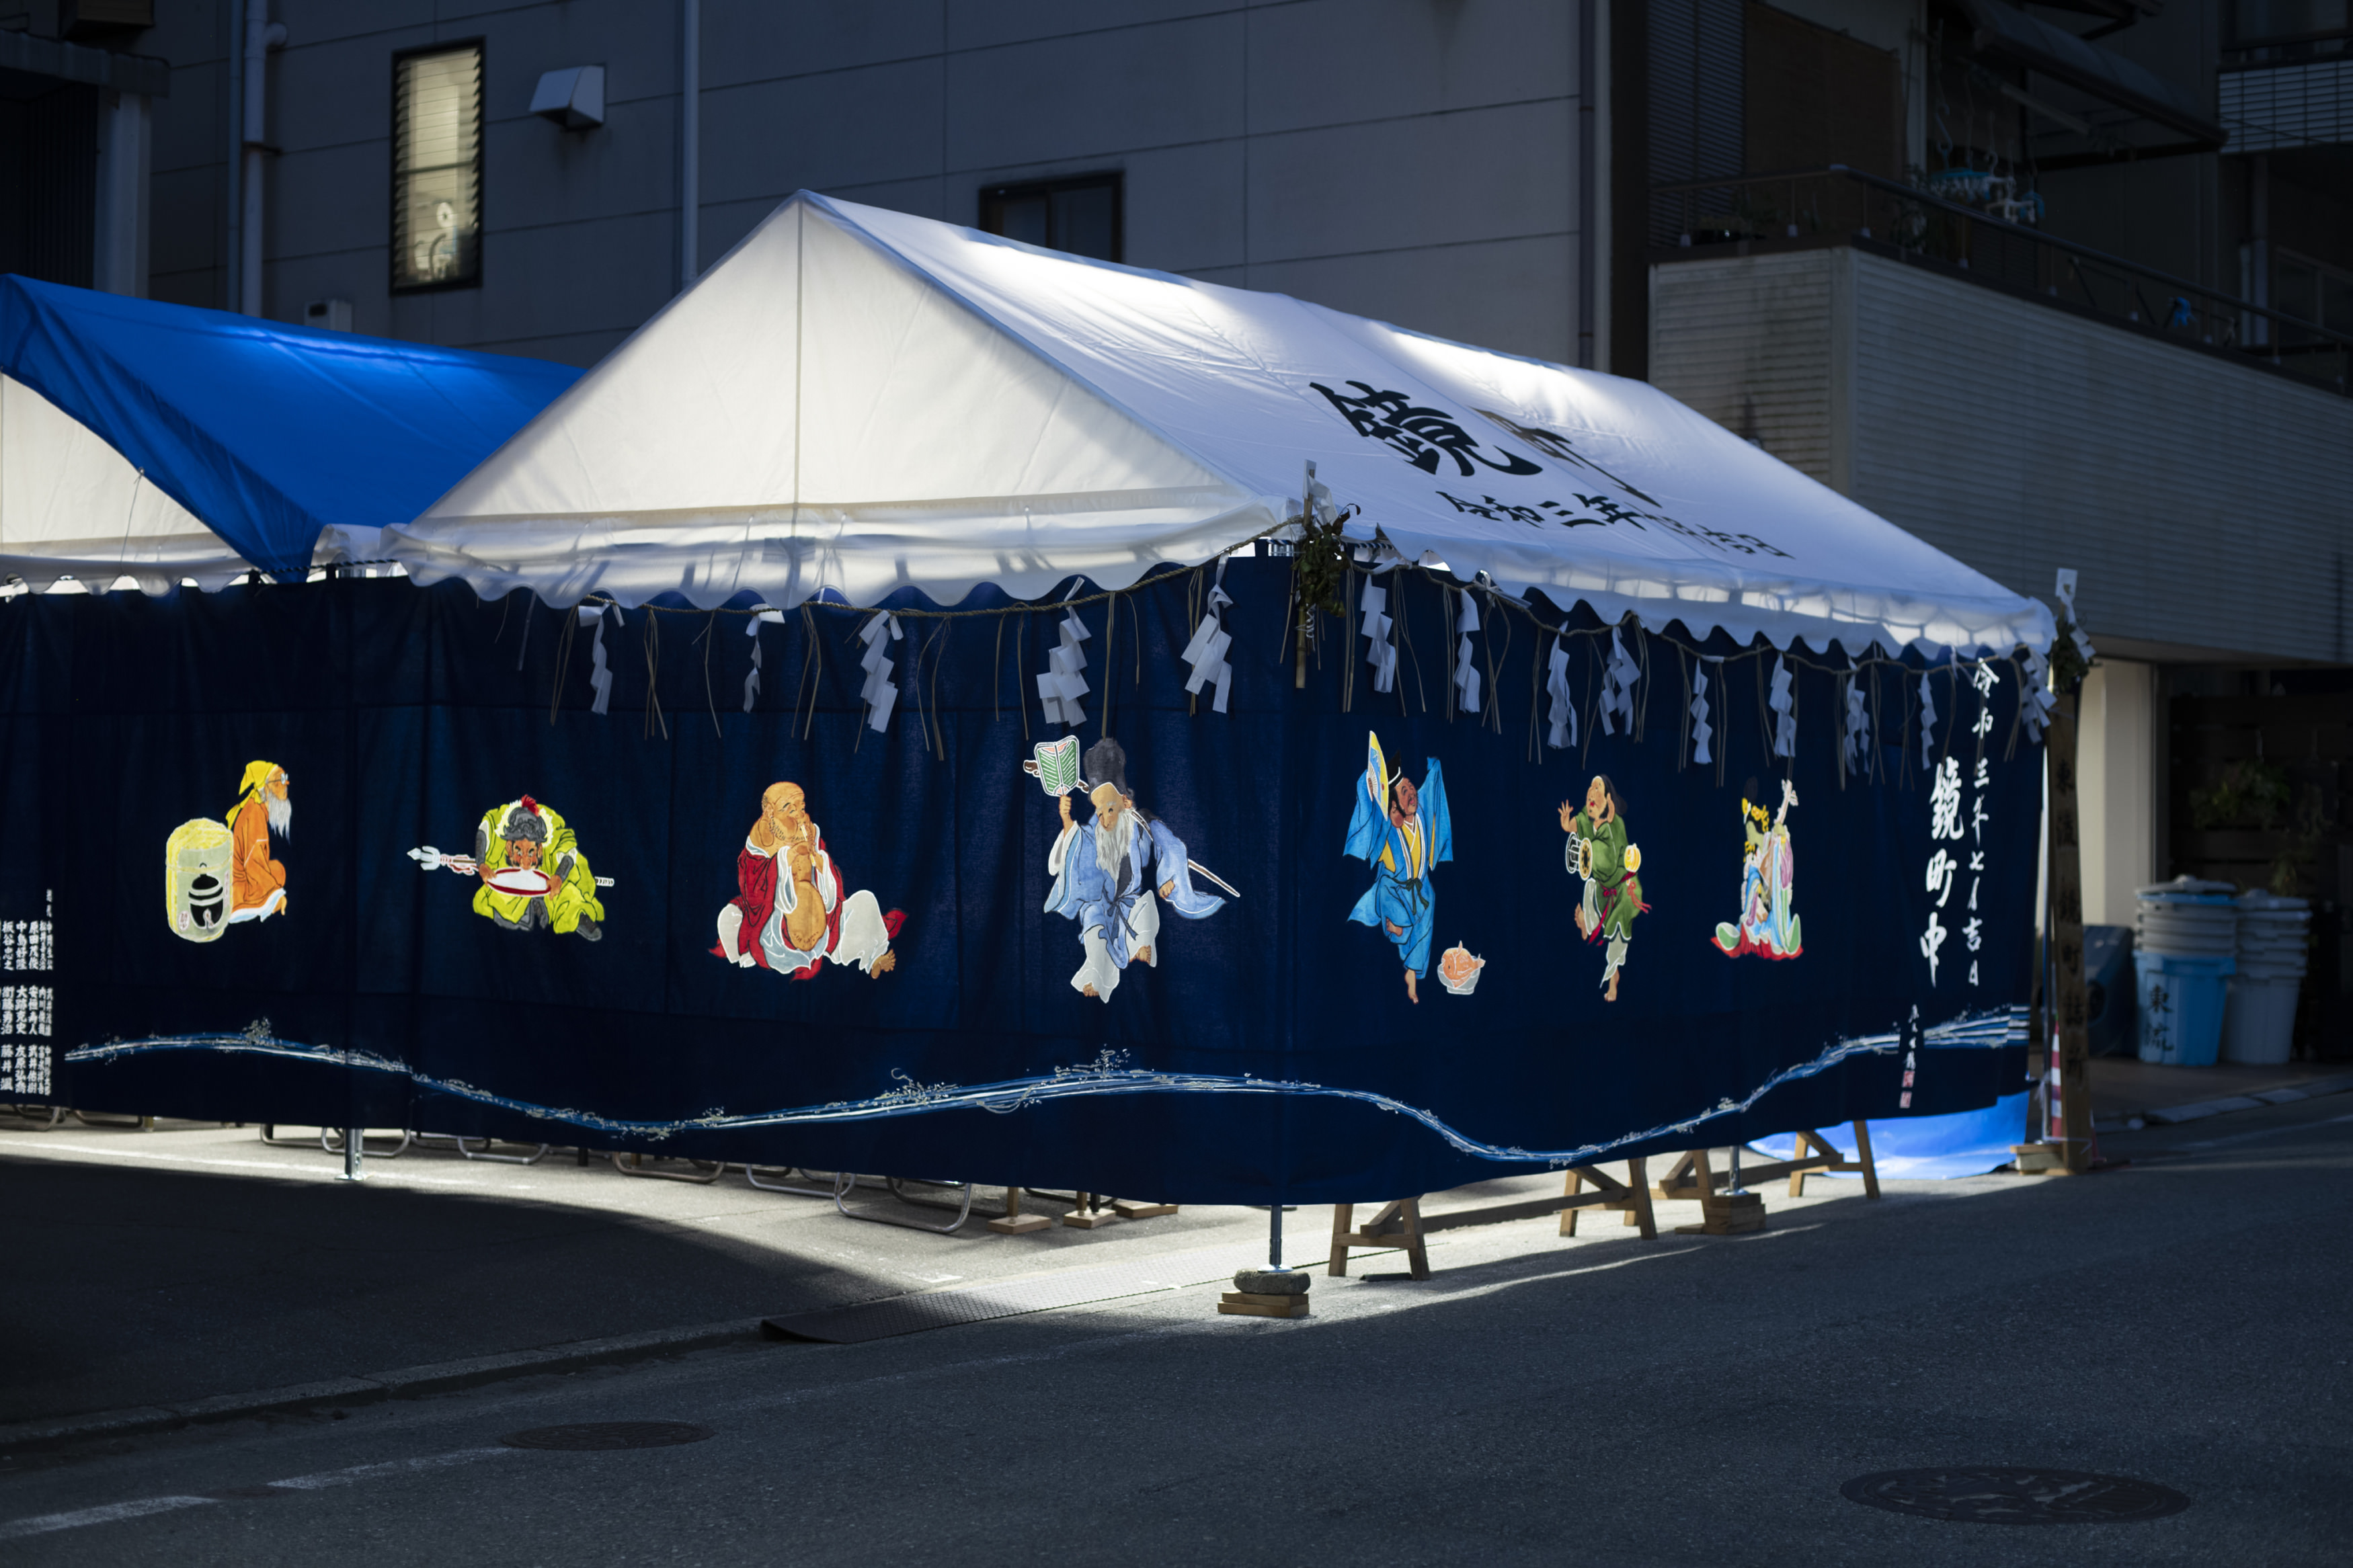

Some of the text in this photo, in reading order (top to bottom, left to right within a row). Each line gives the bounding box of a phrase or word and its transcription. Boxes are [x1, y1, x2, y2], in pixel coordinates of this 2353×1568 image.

[1310, 380, 1663, 508] 鏡町
[1435, 491, 1796, 559] 令和三年七月吉日
[1919, 755, 1965, 989] 鏡町中
[2144, 984, 2174, 1052] 東流
